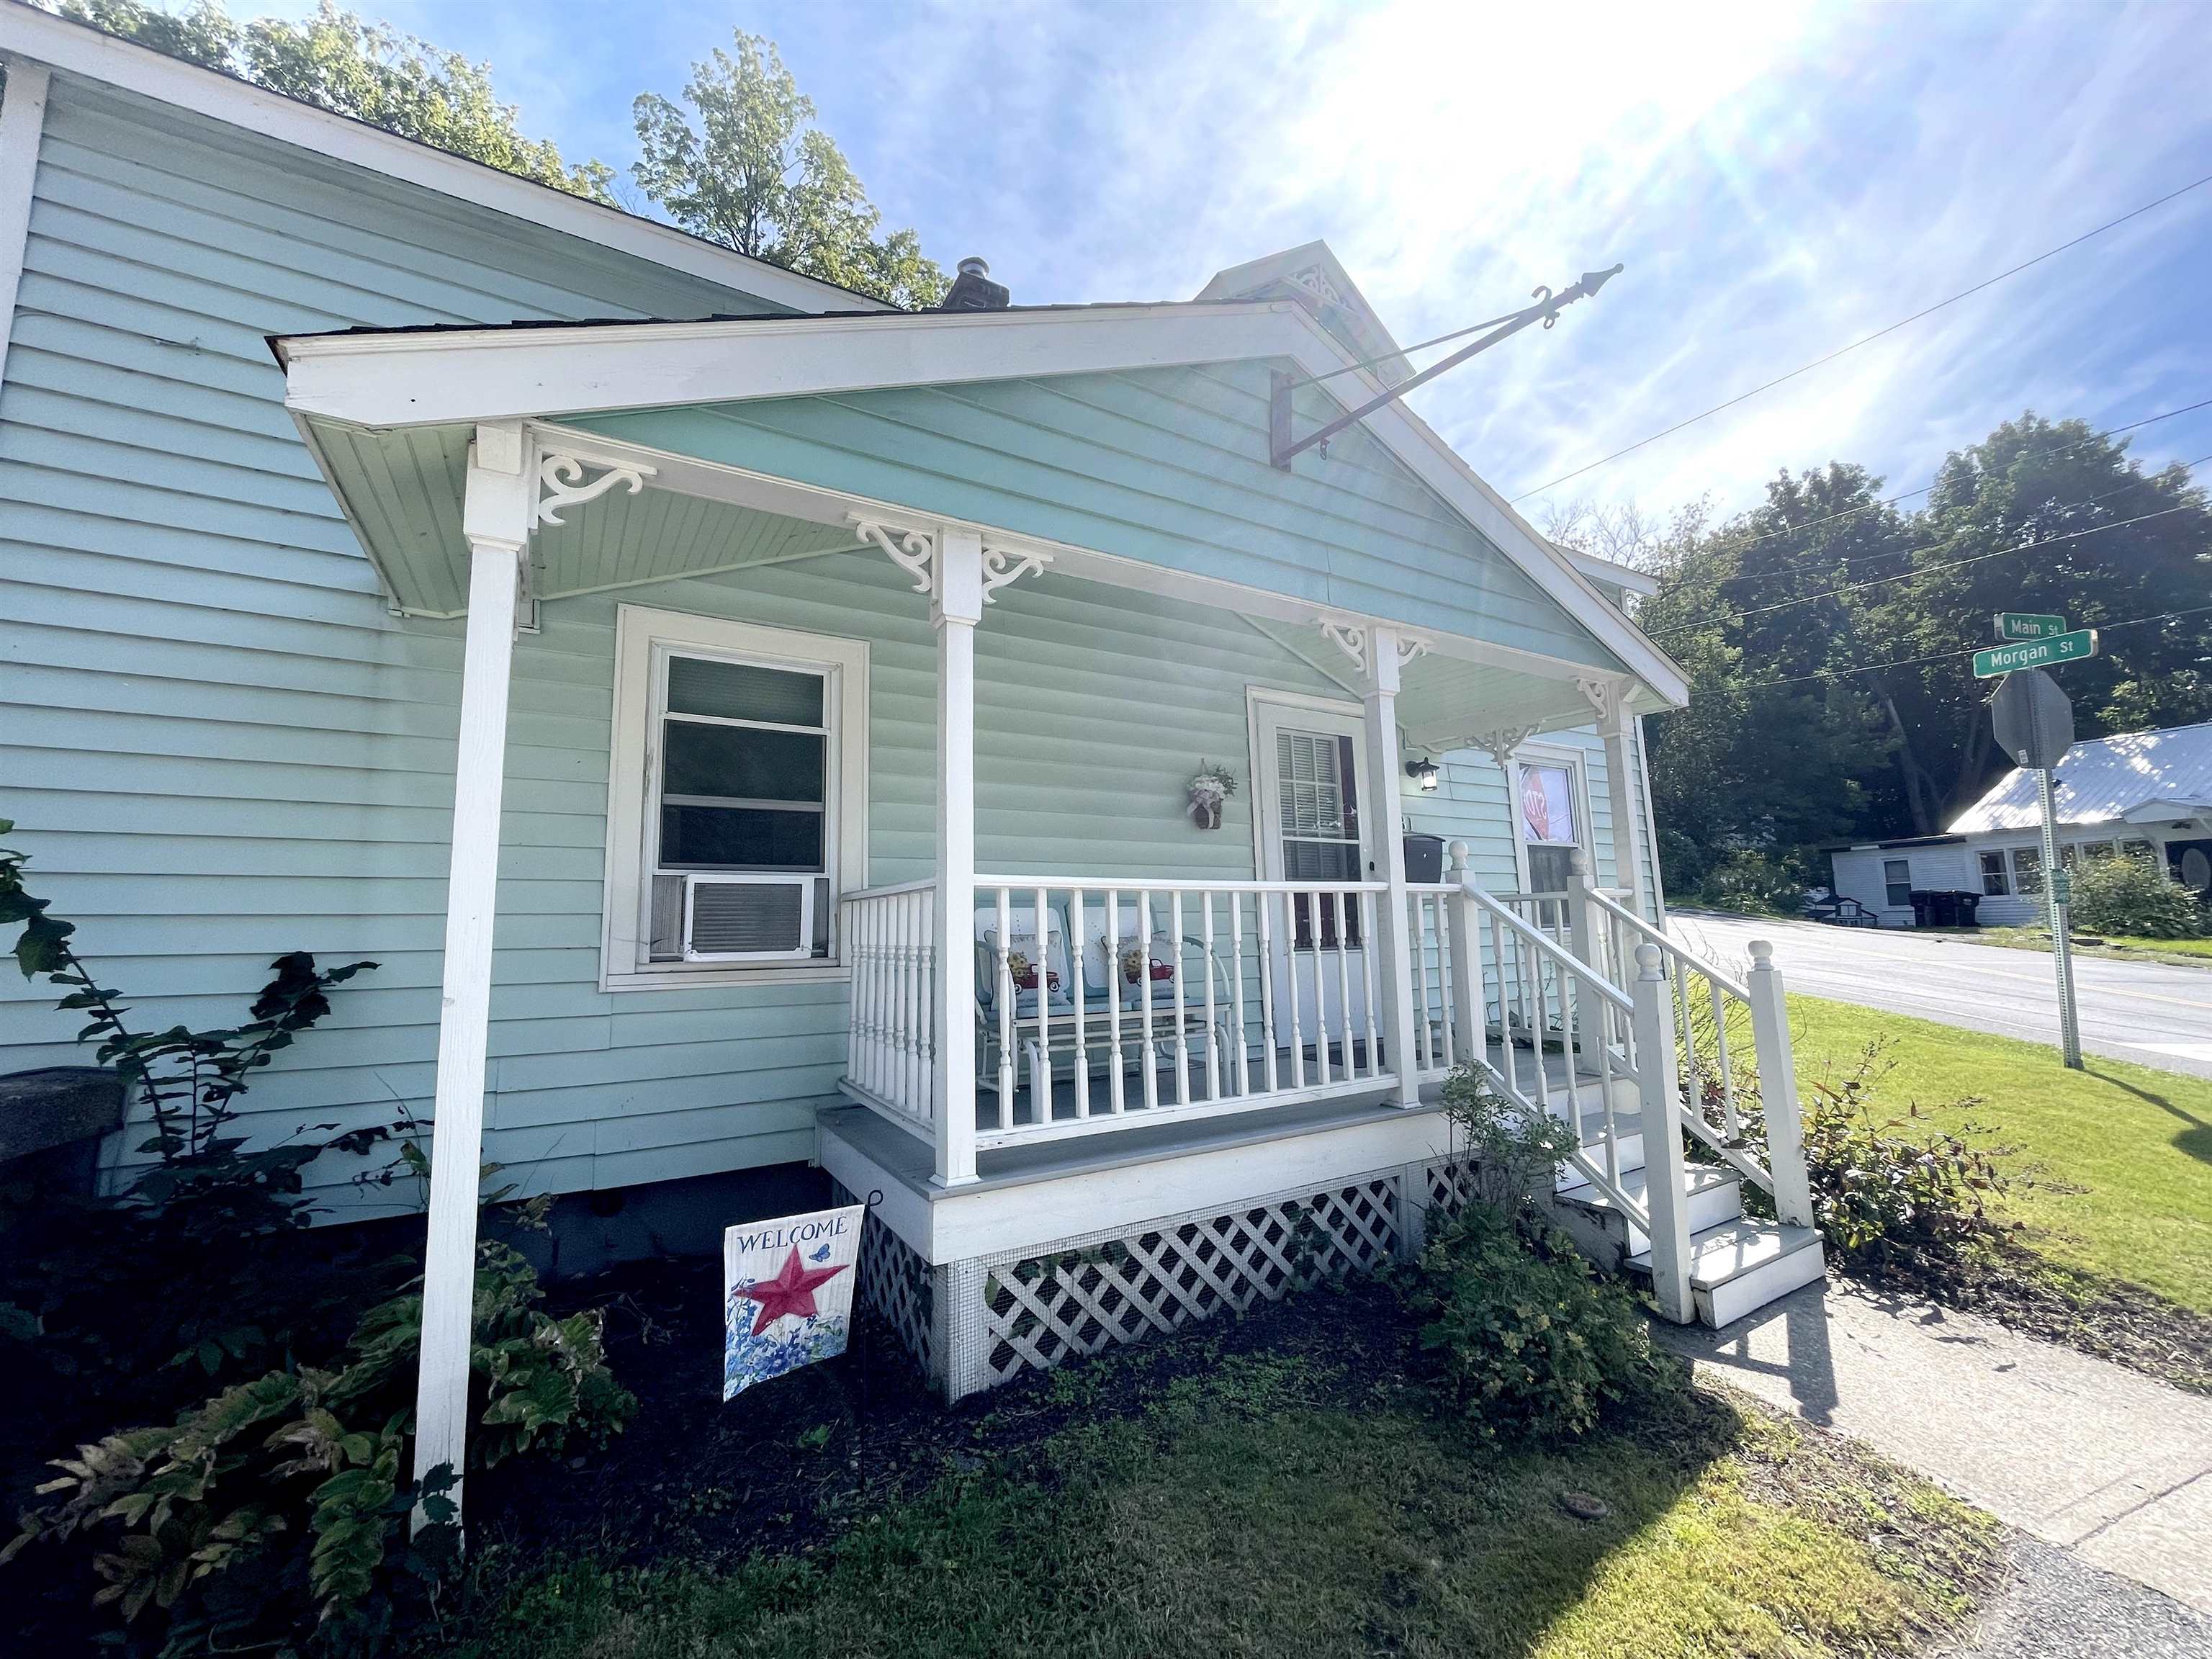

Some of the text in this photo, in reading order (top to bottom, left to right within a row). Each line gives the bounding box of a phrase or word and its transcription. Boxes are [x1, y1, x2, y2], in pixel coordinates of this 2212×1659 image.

[2011, 619, 2058, 636] Main St
[1991, 641, 2074, 667] Morgan St
[737, 1216, 848, 1254] WELCOME
